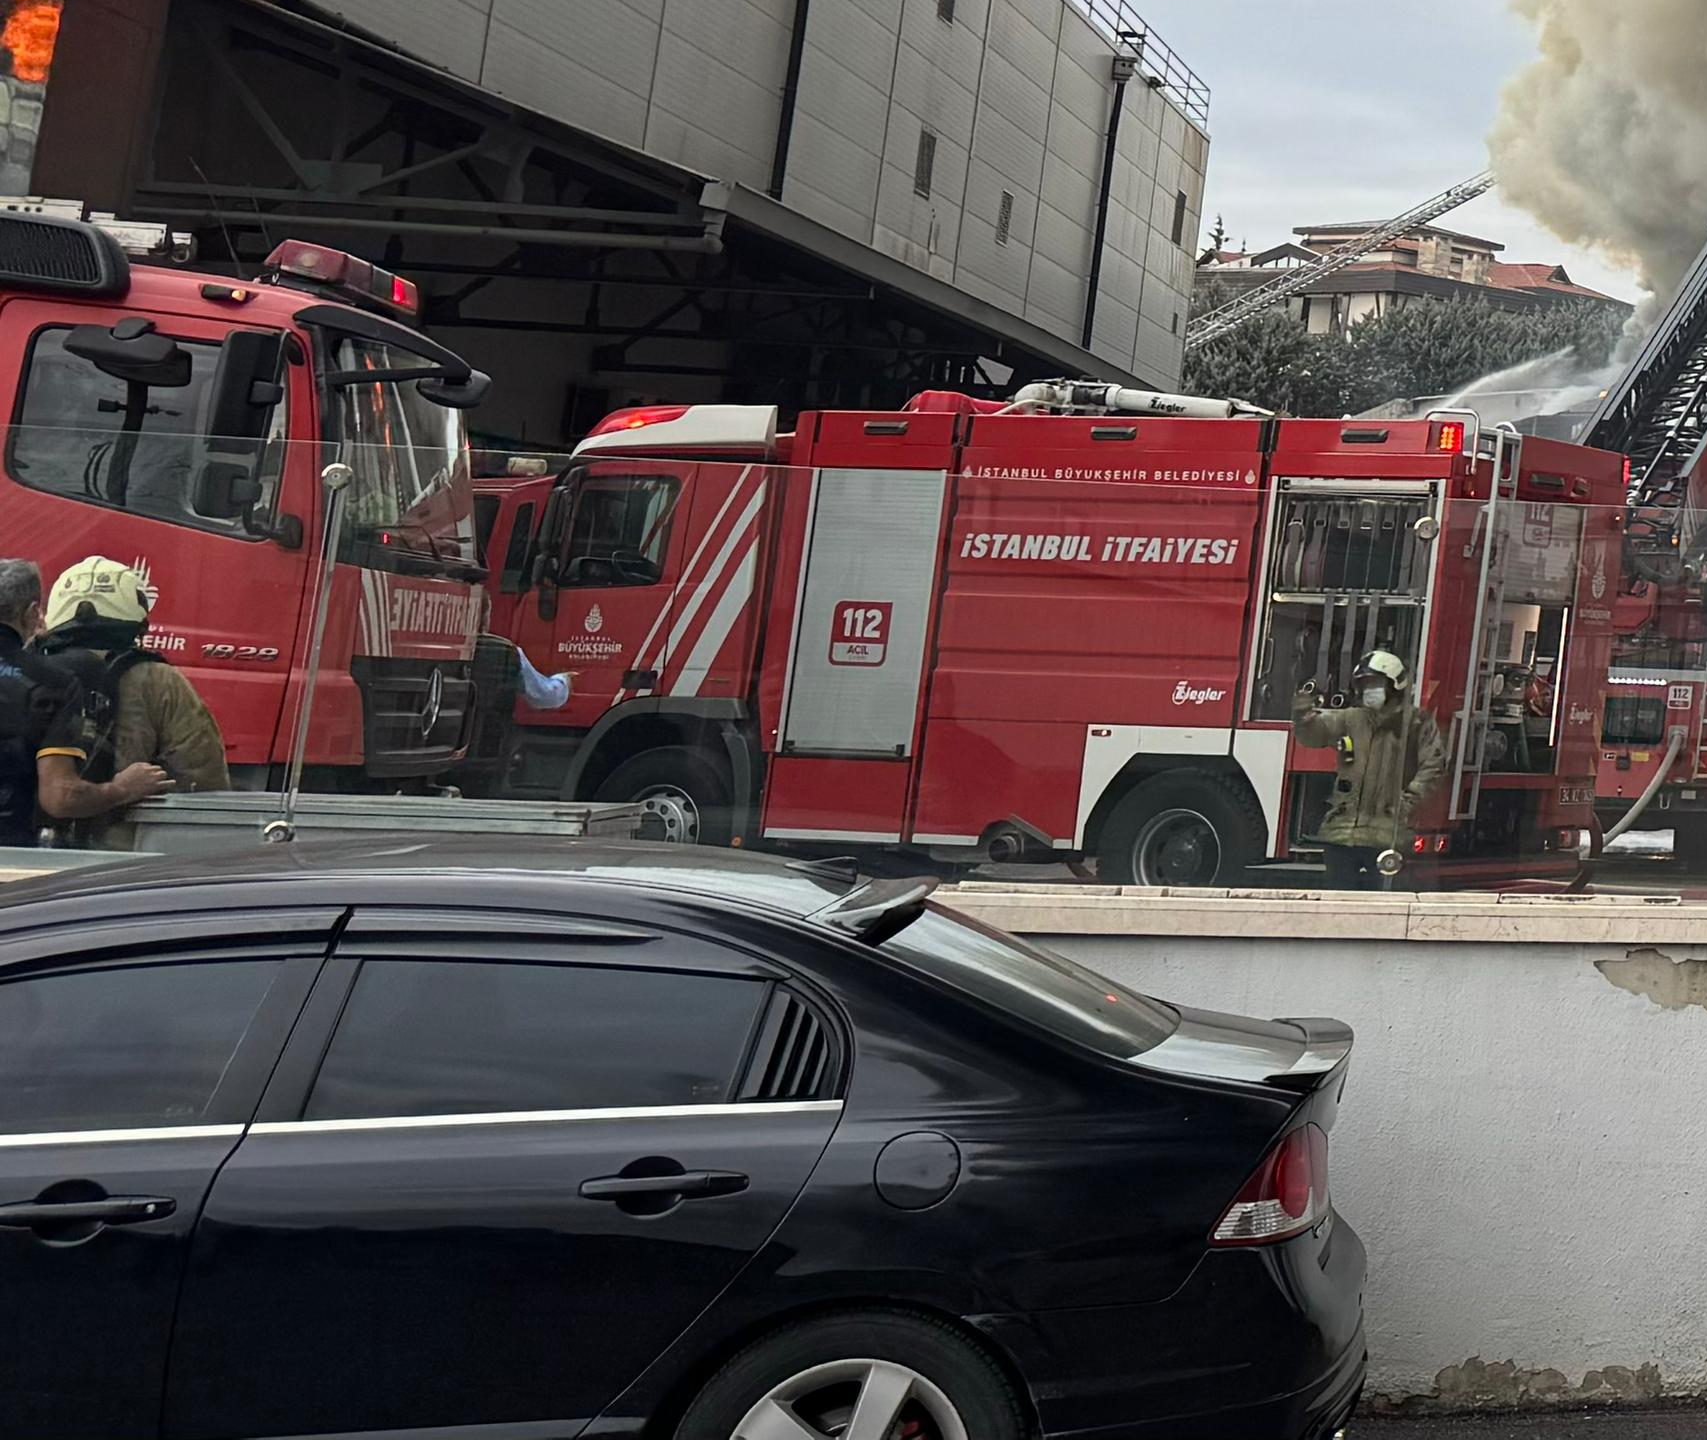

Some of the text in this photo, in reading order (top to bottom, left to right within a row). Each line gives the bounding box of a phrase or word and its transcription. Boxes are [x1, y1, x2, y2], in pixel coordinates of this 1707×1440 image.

[977, 465, 1048, 478] İSTANBUL
[1154, 469, 1240, 482] BELEDİYESİ
[843, 608, 883, 638] 112
[1172, 680, 1227, 705] Ziegler
[1673, 688, 1689, 699] 112
